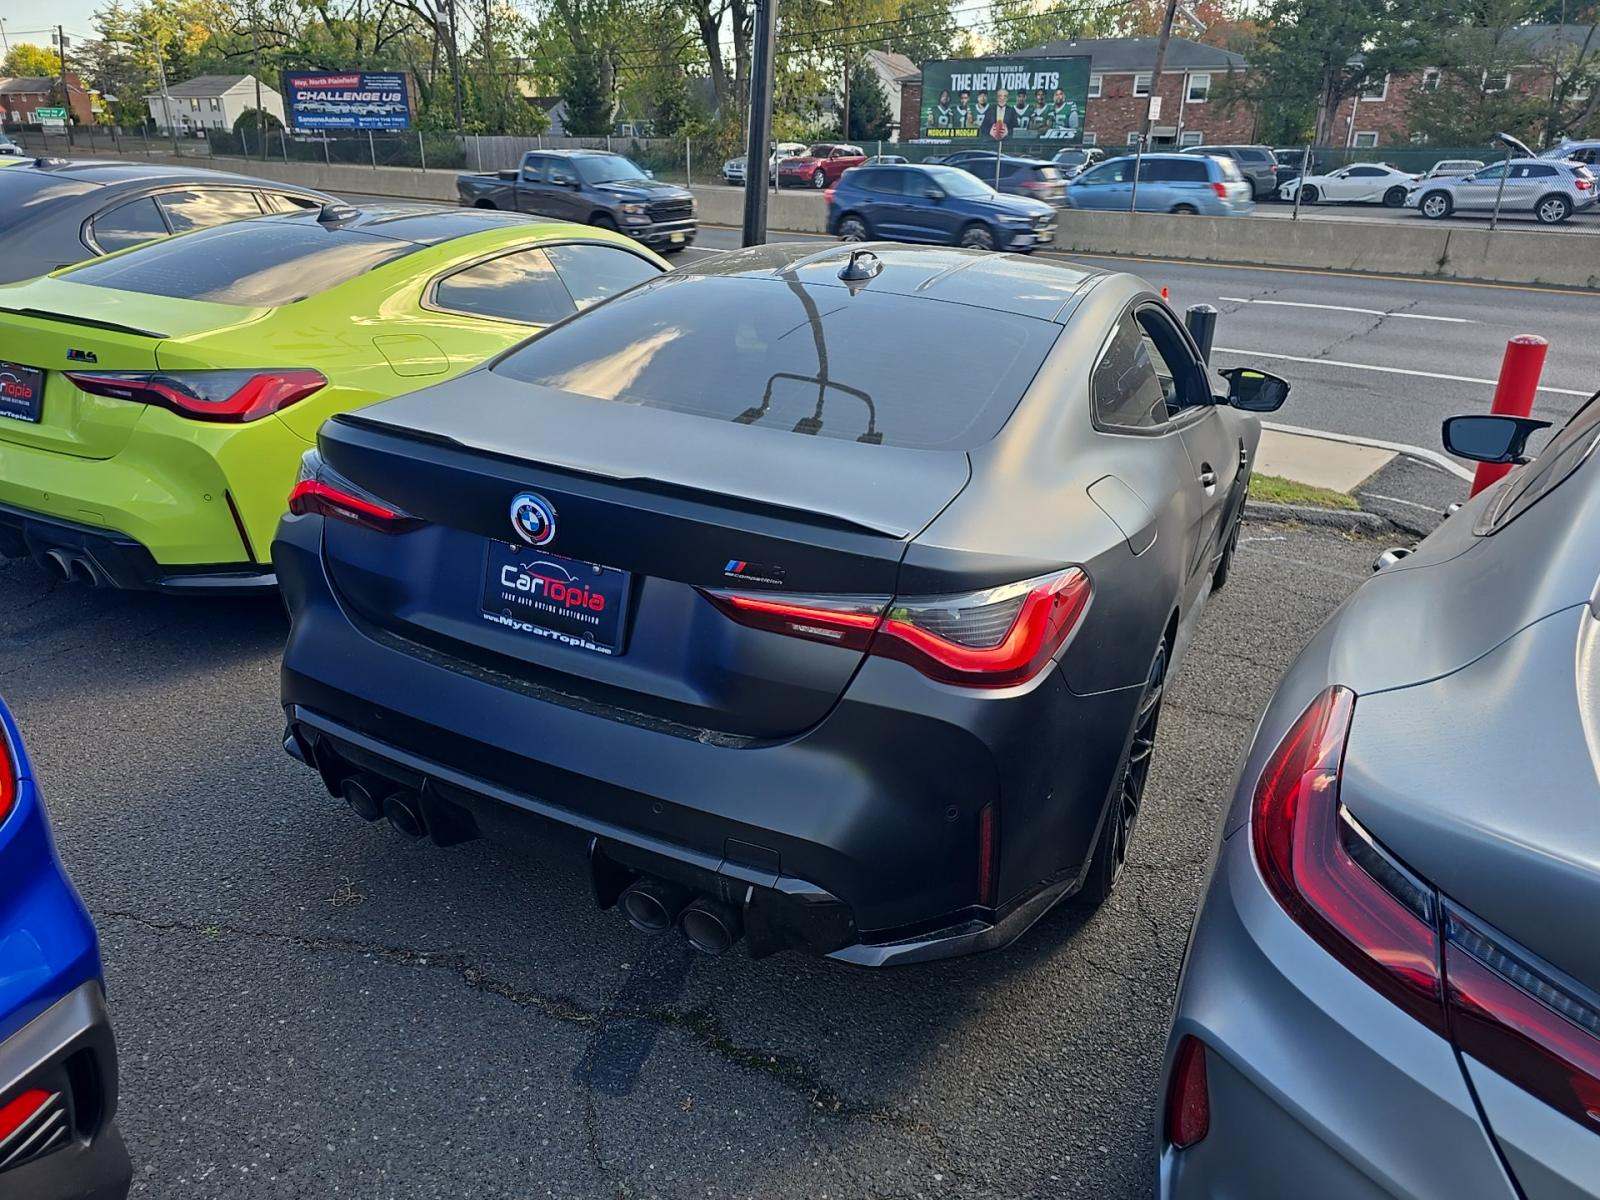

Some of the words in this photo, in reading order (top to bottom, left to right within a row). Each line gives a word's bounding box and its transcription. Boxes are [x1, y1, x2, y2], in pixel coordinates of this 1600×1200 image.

[951, 74, 971, 91] THE
[972, 73, 998, 91] NEW
[1000, 72, 1031, 90] YORK
[1031, 72, 1059, 90] JETS
[297, 91, 380, 100] CHALLENGE
[382, 92, 401, 101] US
[928, 129, 950, 137] MORGAN
[955, 129, 978, 137] MORGAN
[1040, 128, 1077, 139] JETS
[501, 564, 606, 611] CarTopia
[518, 597, 533, 607] AUTO
